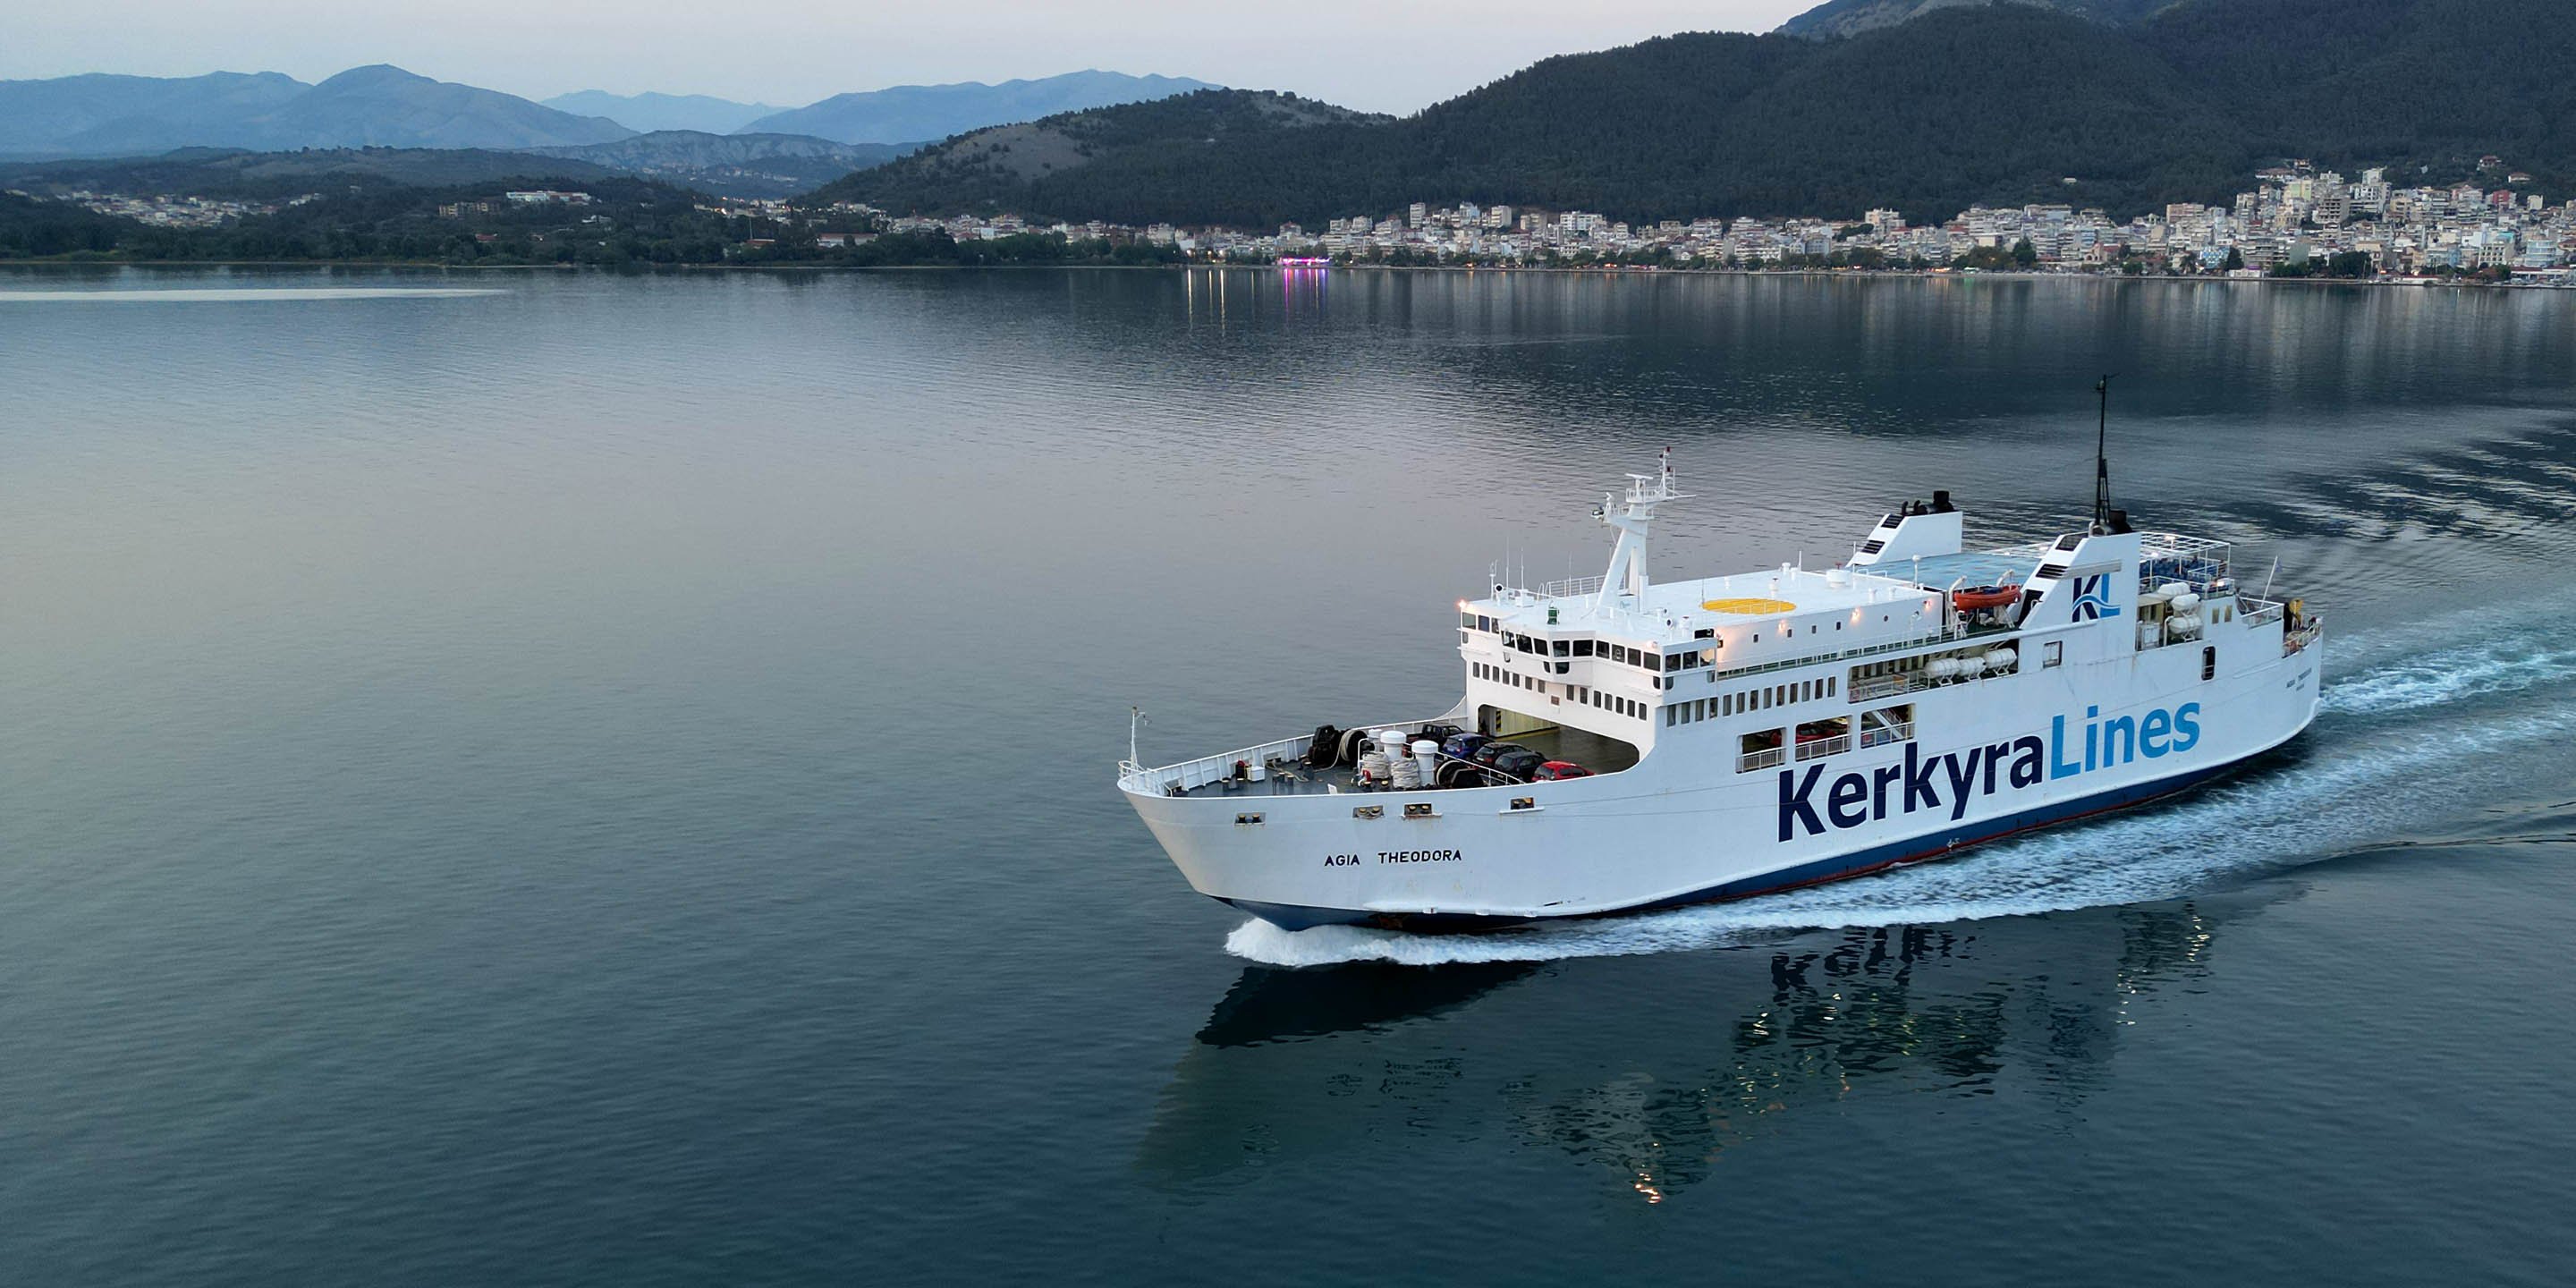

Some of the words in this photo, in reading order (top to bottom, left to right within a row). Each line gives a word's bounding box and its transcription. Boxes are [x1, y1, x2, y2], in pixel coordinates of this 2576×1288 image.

[2072, 572, 2121, 623] KL
[1324, 854, 1360, 867] AGIA
[1377, 849, 1462, 864] THEODORA
